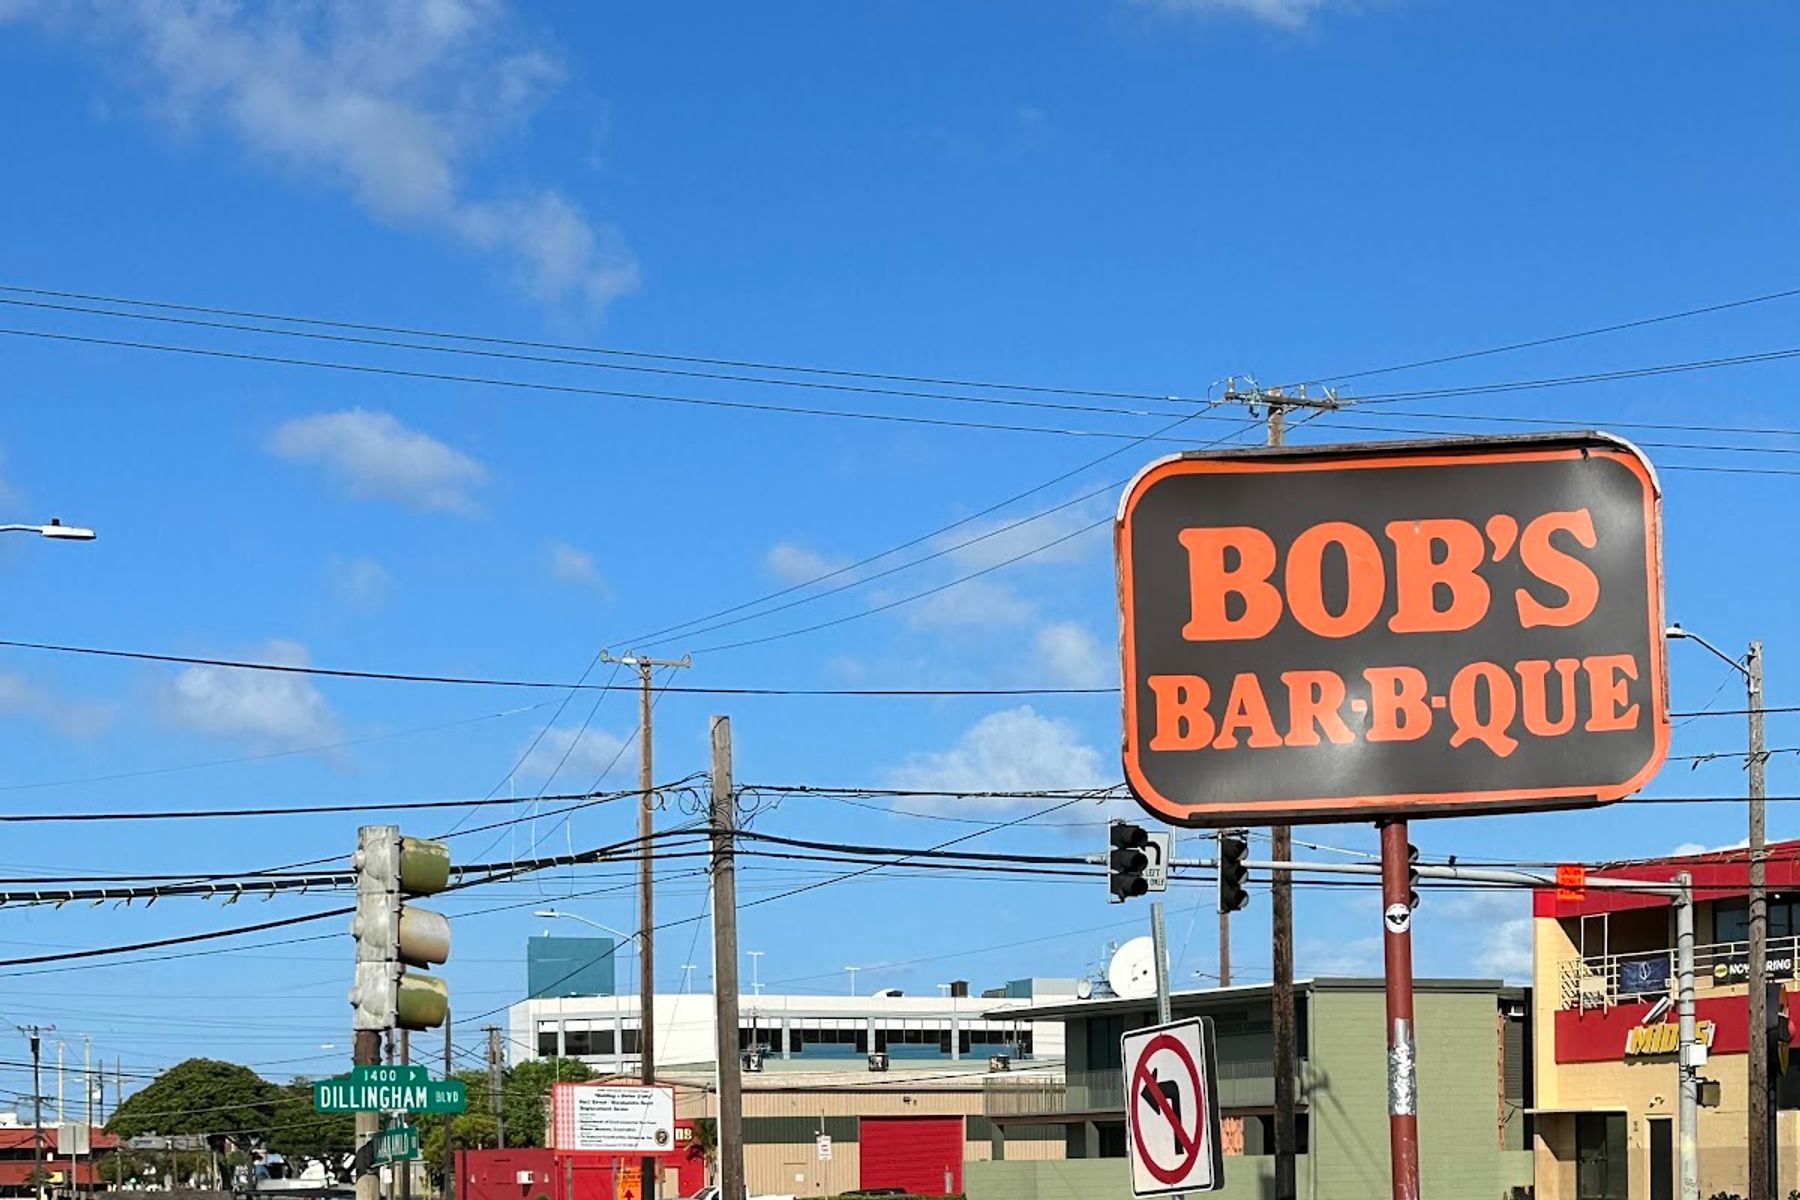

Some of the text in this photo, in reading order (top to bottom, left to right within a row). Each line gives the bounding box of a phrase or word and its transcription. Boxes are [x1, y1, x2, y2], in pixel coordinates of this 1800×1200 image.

[1178, 507, 1600, 641] BOB'S
[1146, 654, 1641, 758] BAR-B-QUE
[1765, 958, 1792, 972] RING
[1627, 1020, 1714, 1055] MIDS
[364, 1070, 397, 1082] 1400
[320, 1086, 459, 1109] DILLINGHAM BLVD
